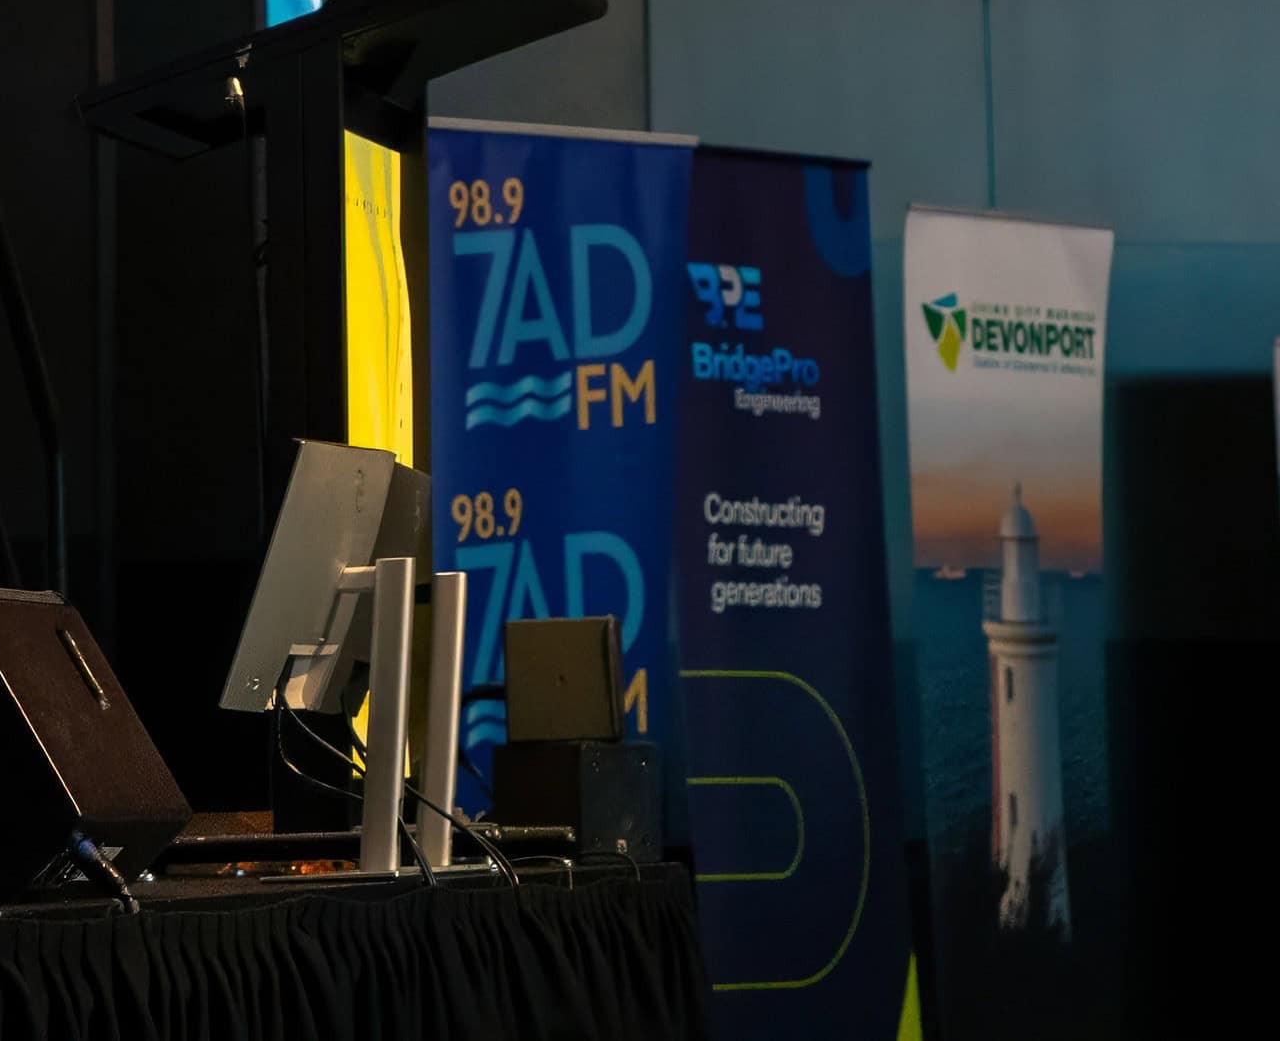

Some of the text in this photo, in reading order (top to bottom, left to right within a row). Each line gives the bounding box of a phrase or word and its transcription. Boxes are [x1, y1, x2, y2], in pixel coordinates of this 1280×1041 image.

[449, 177, 524, 228] 98.9
[452, 223, 654, 369] 7AD
[971, 318, 1096, 359] DEVONPORT
[691, 342, 820, 390] BridgePro
[576, 360, 657, 431] FM
[734, 388, 821, 420] Engineering
[451, 489, 523, 542] 98.9
[703, 491, 825, 537] Constructing
[707, 531, 793, 569] for future
[711, 574, 823, 614] generations
